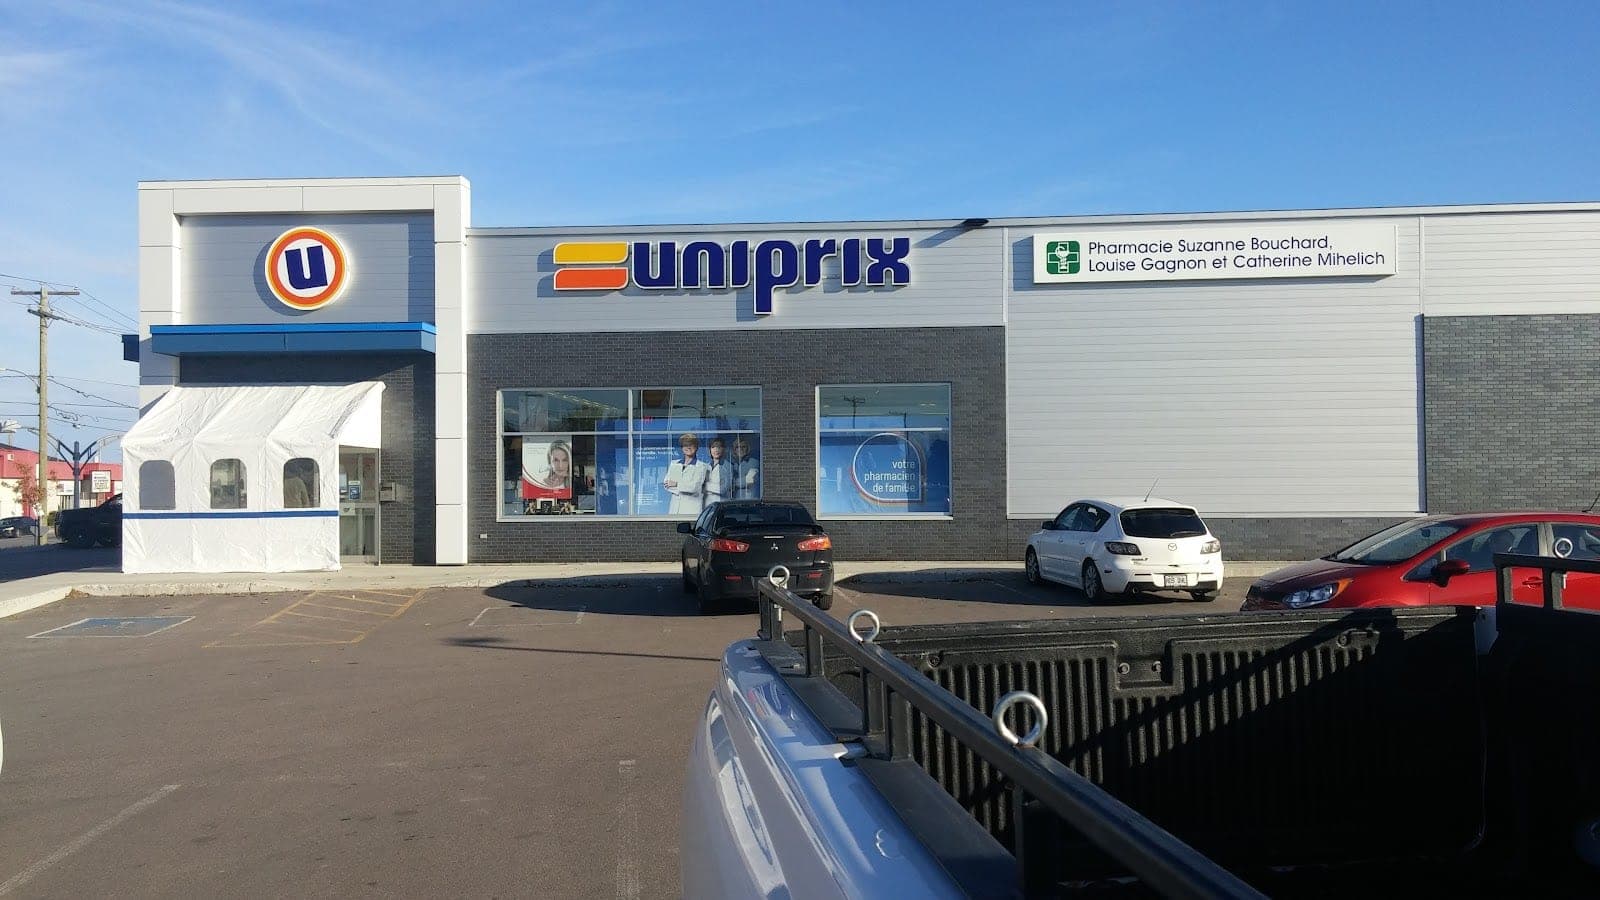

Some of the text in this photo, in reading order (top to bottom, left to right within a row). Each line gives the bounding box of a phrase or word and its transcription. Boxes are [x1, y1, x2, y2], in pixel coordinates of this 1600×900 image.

[1088, 236, 1333, 255] Pharmacie Suzanne Bouchard,
[1088, 251, 1385, 274] Louise Gagnon et Catherine Mihelich
[632, 237, 911, 315] uniprix
[892, 459, 915, 469] votre
[864, 471, 916, 484] pharmacien
[873, 483, 916, 493] de famille
